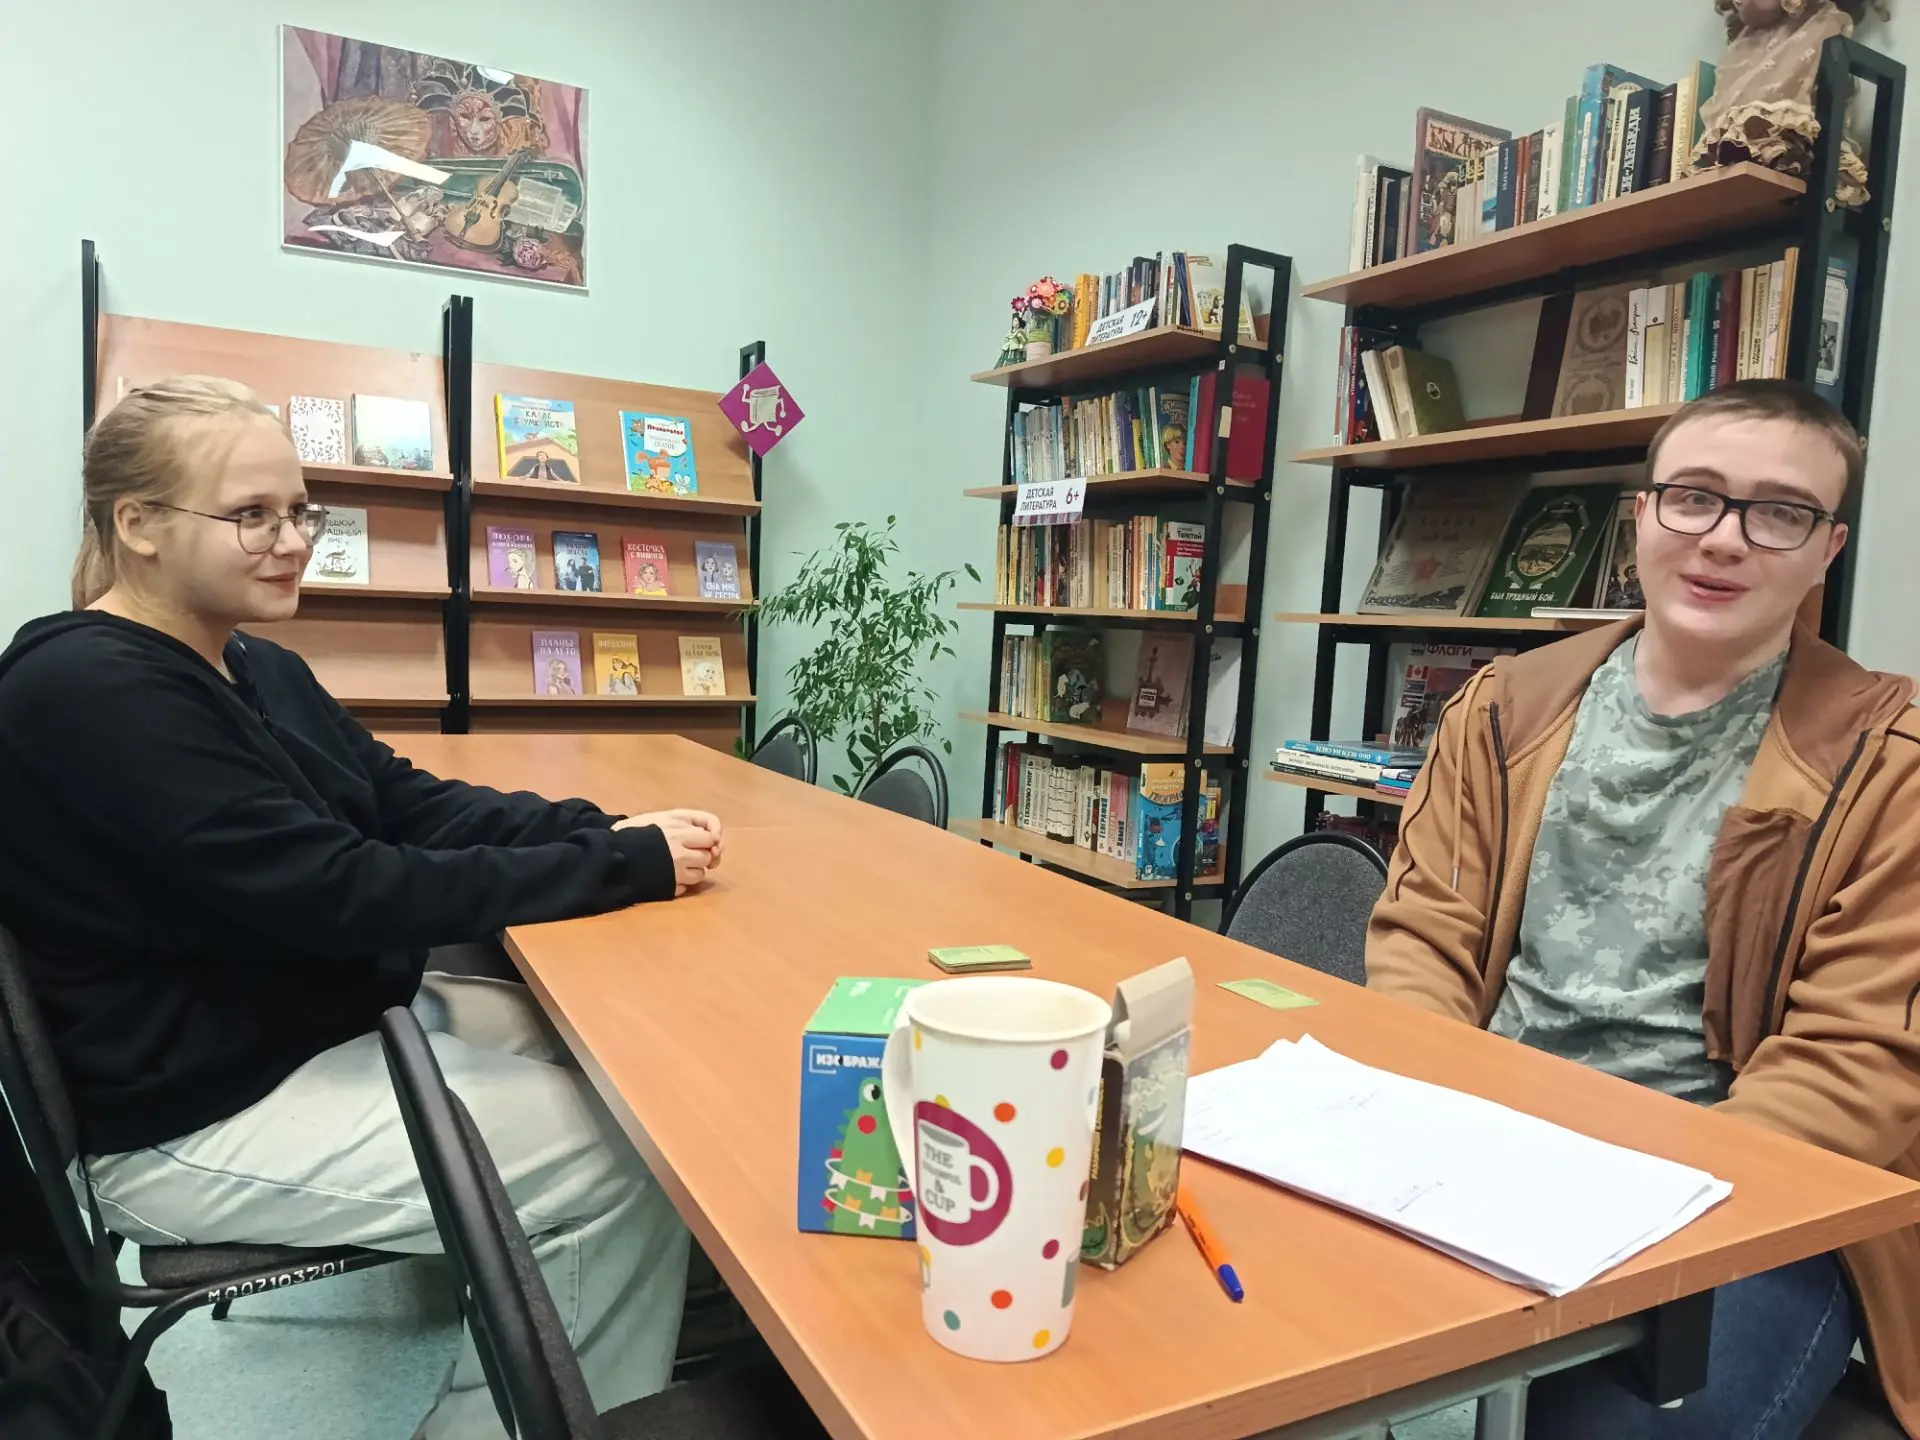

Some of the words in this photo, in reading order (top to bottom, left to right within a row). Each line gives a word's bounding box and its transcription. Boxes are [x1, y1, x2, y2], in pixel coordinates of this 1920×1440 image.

[1096, 315, 1124, 333] ДЕТСКАЯ
[1130, 309, 1148, 328] 12+
[1092, 327, 1123, 341] ЛИТЕРАТУРА
[1026, 486, 1054, 499] ДЕТСКАЯ
[1065, 487, 1080, 504] 6+
[1020, 500, 1057, 511] ЛИТЕРАТУРА
[627, 543, 665, 552] КОСТОЧКА
[705, 582, 720, 590] ОНА
[722, 583, 736, 592] МНЕ
[1490, 592, 1504, 600] БЫЛ
[1505, 591, 1538, 601] ТРУДНЫЙ
[816, 1053, 883, 1069] ИЗОБРАЖ
[924, 1142, 954, 1169] THE
[934, 1179, 945, 1194] &
[925, 1189, 956, 1213] CUP
